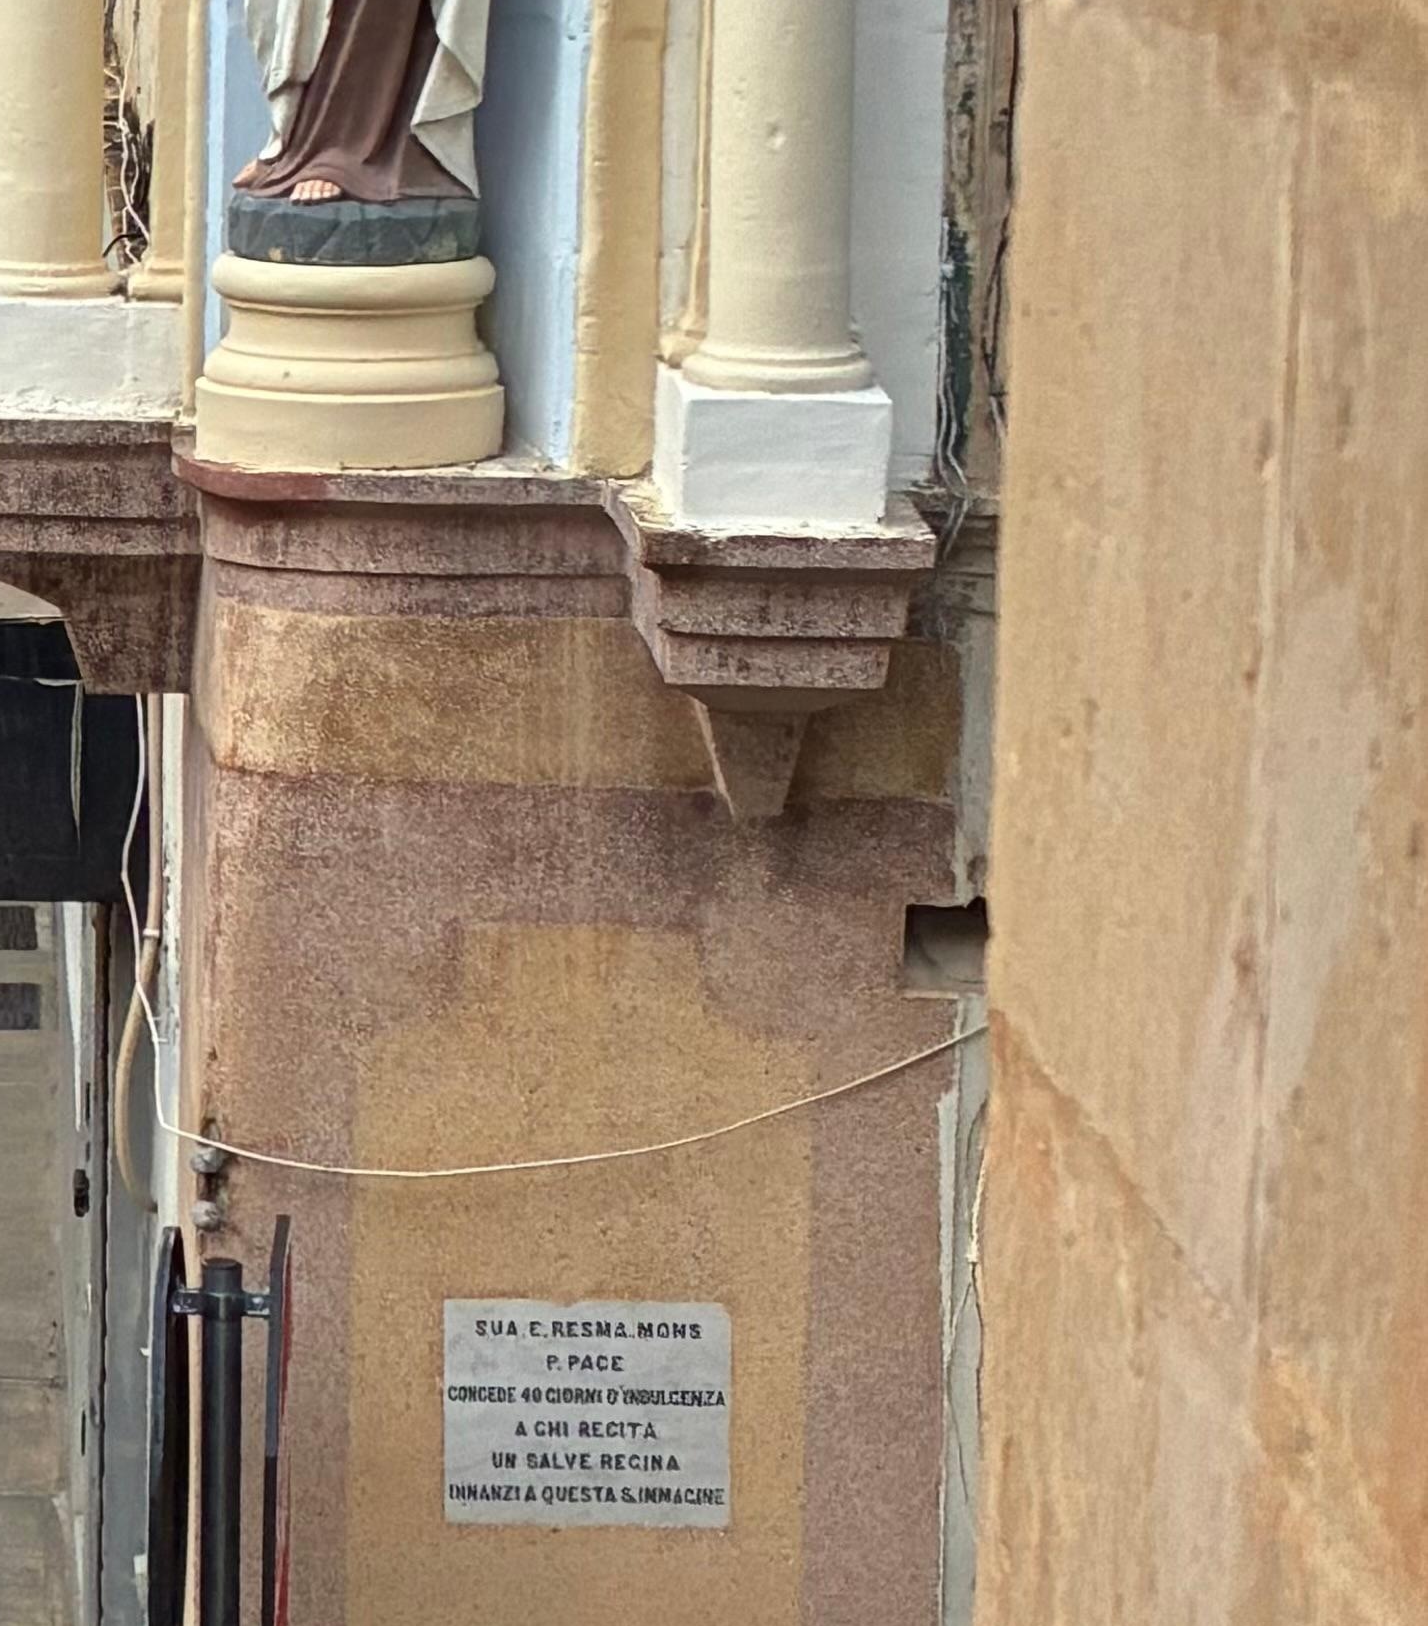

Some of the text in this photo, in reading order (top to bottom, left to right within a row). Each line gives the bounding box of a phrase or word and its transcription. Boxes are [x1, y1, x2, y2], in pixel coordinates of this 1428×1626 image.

[567, 1354, 625, 1373] PACE
[447, 1385, 517, 1404] CONCEDE
[520, 1386, 543, 1404] 40
[514, 1420, 658, 1440] A CHI RECITA
[491, 1451, 681, 1472] UN SALVE REGINA
[523, 1484, 538, 1503] A
[541, 1485, 618, 1506] QUESTA
